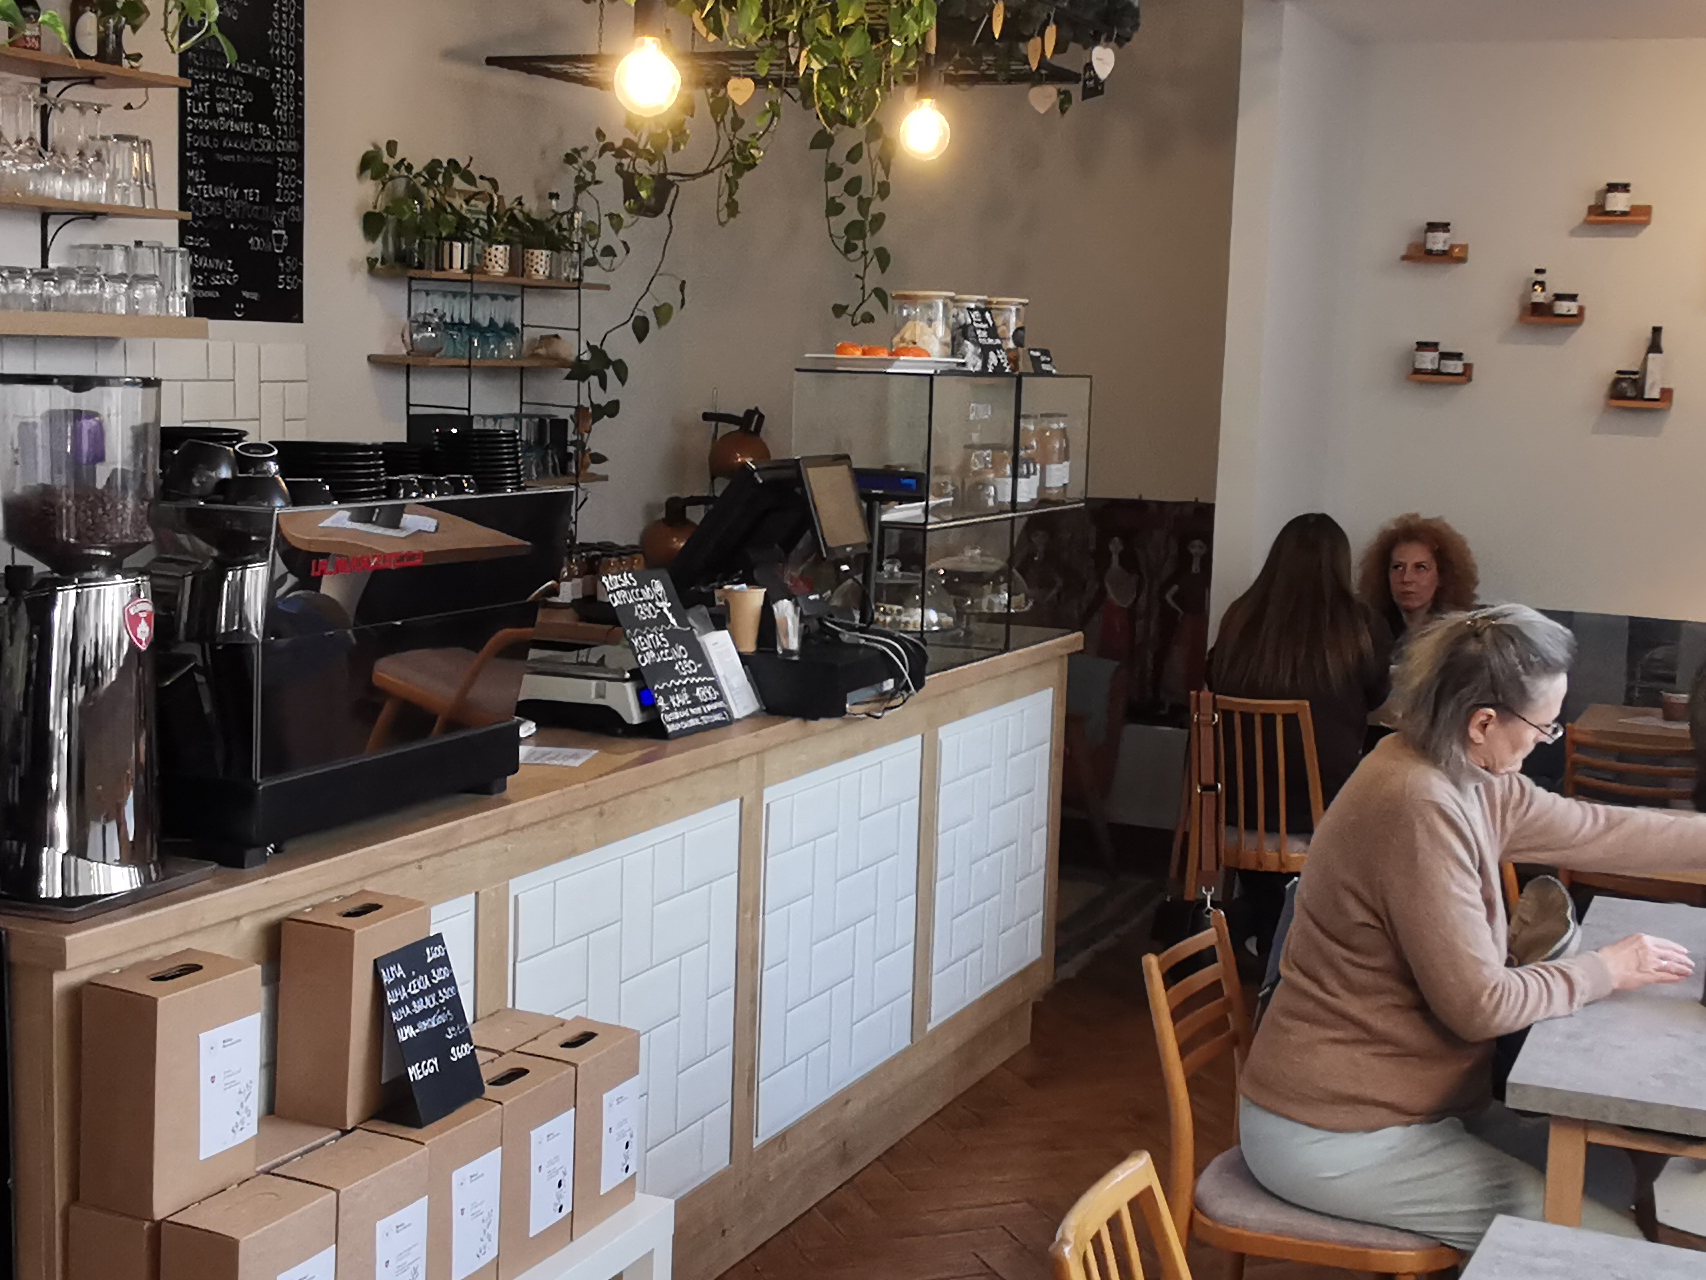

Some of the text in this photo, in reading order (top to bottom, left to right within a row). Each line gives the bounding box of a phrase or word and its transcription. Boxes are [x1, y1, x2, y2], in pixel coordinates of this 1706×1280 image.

[186, 98, 211, 114] FLAT
[186, 152, 205, 165] TEA
[381, 963, 407, 985] ALMA
